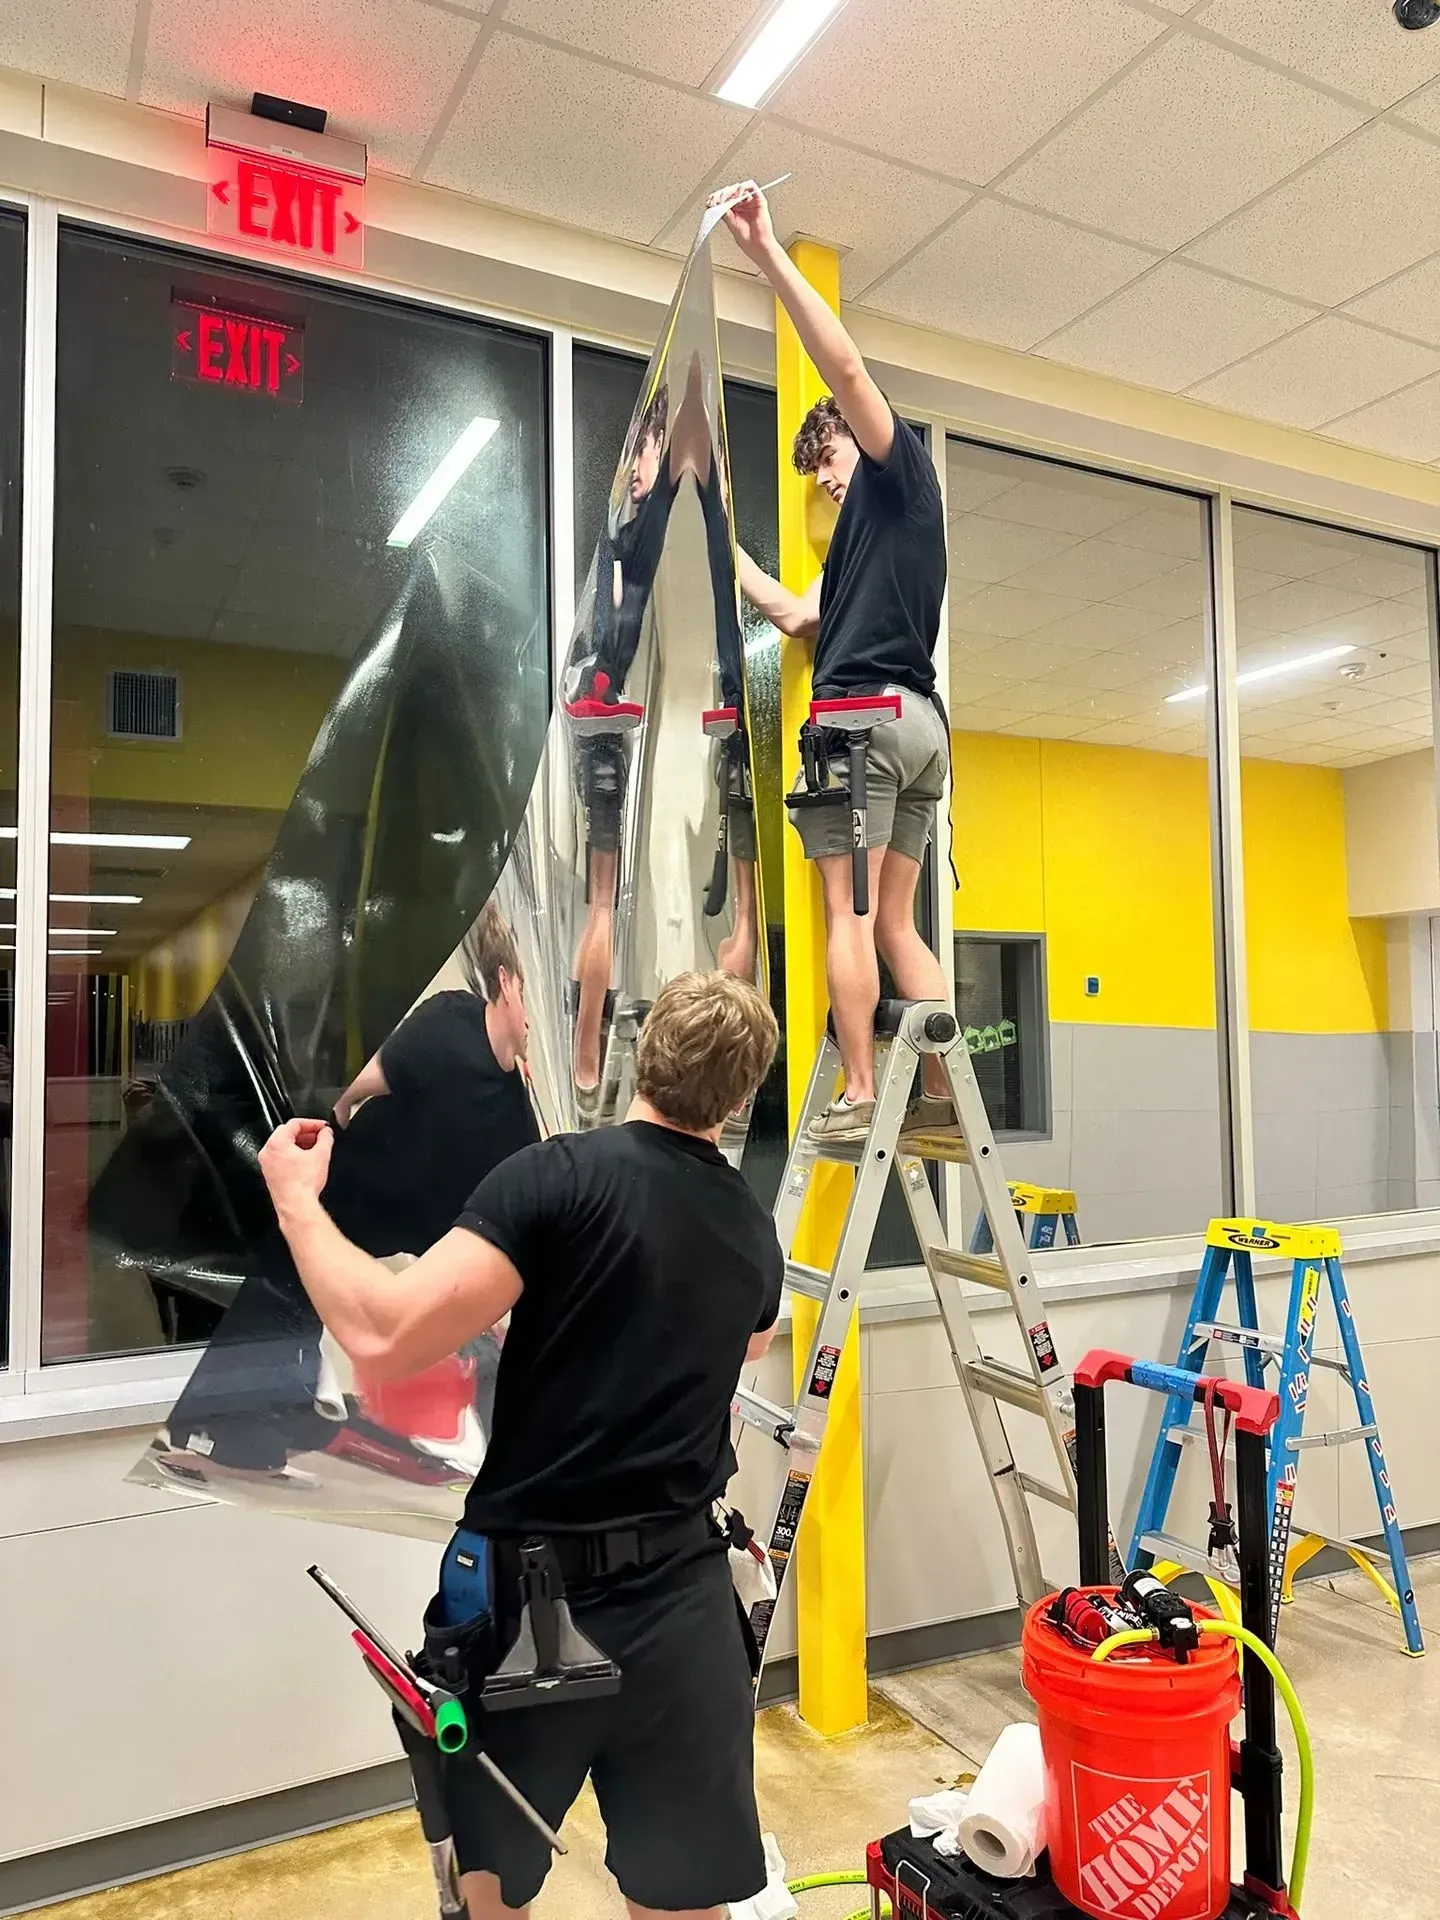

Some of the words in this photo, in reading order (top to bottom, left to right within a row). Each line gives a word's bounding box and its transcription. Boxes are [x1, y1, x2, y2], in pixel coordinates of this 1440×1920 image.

[238, 158, 343, 254] EXIT
[198, 313, 285, 392] EXIT
[1238, 1237, 1270, 1246] WERNER
[1080, 1778, 1209, 1911] HOME
[1087, 1792, 1147, 1844] THE
[1131, 1826, 1209, 1920] DEPOT
